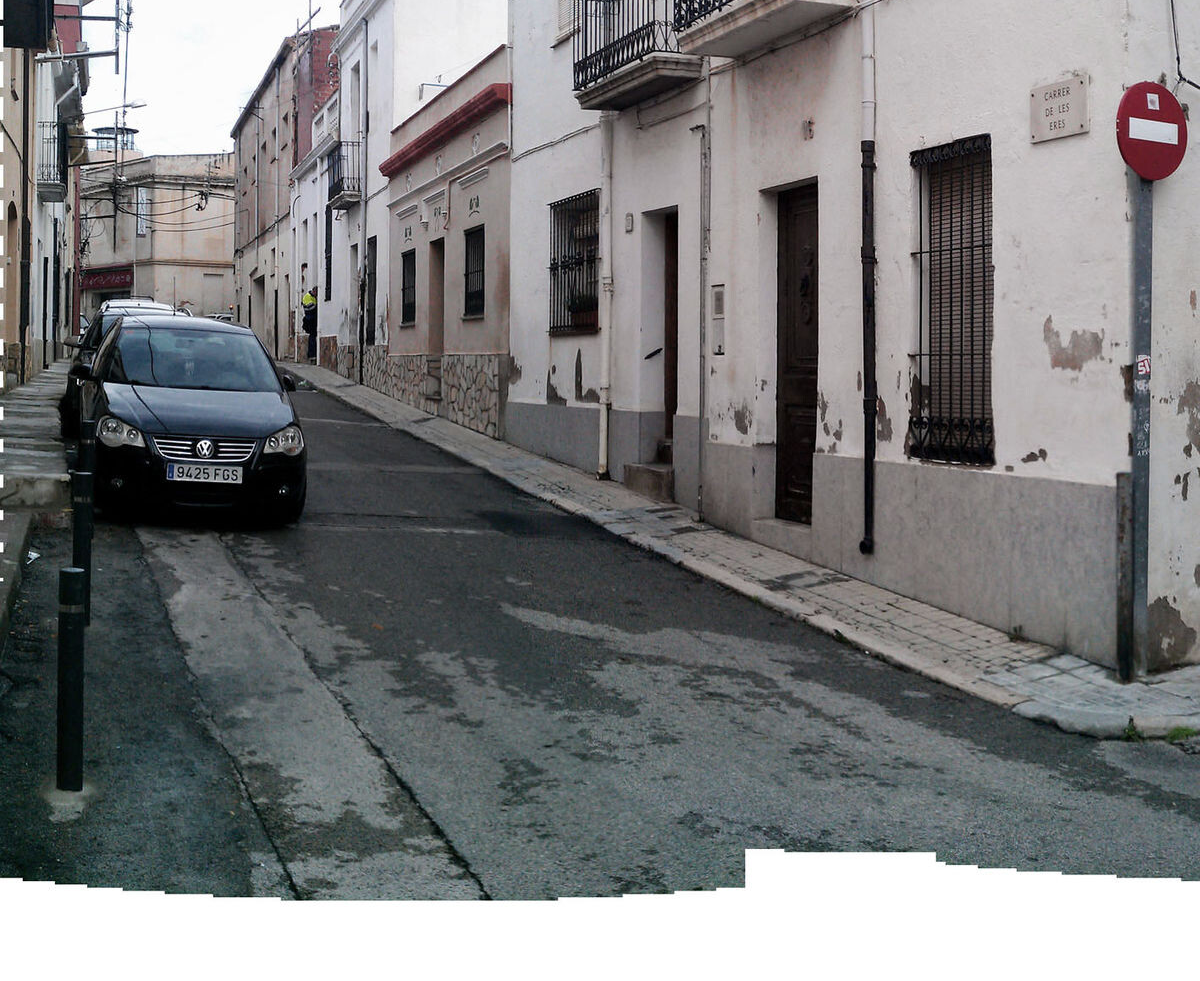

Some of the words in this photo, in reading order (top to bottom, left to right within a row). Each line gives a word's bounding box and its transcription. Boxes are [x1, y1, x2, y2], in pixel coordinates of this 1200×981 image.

[1044, 86, 1071, 101] CARRER
[1045, 107, 1054, 117] DE
[1058, 103, 1070, 114] LES
[1049, 119, 1065, 131] ERES
[177, 466, 210, 480] 9425
[213, 468, 239, 482] FGS
